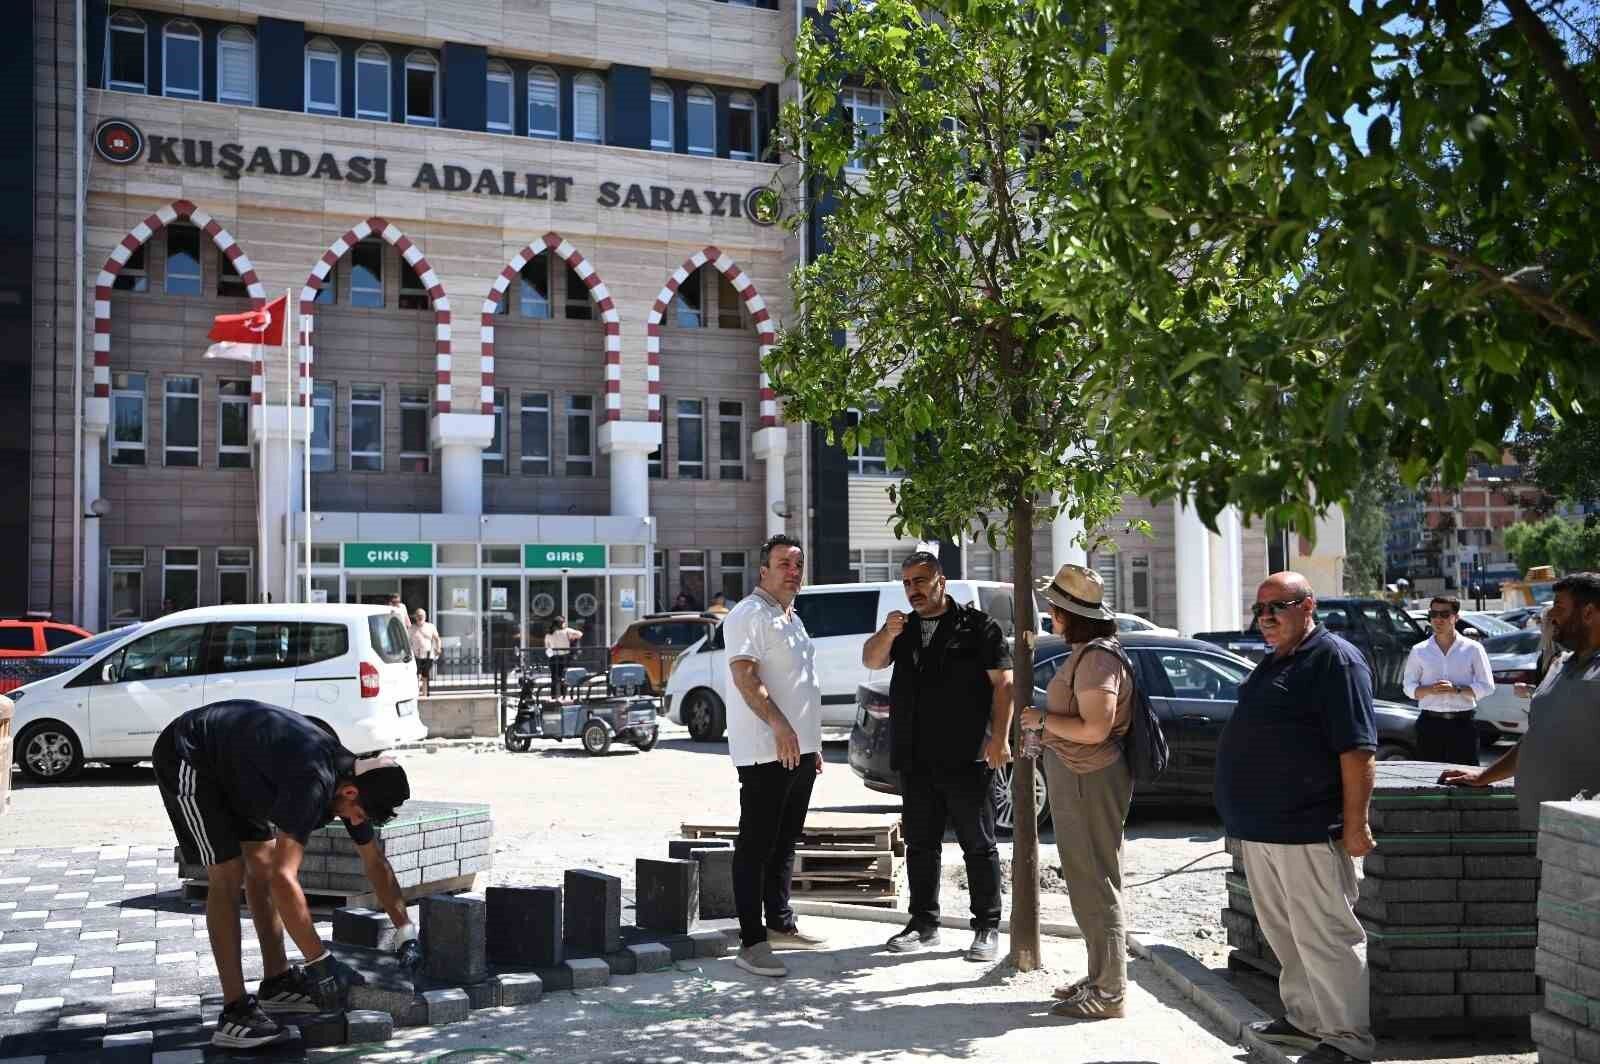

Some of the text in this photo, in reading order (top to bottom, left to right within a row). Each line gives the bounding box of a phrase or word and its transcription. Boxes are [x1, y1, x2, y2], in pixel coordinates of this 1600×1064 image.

[147, 134, 741, 218] KUŞADASI ADALET SARAYI
[367, 550, 409, 563] ÇIKIŞ
